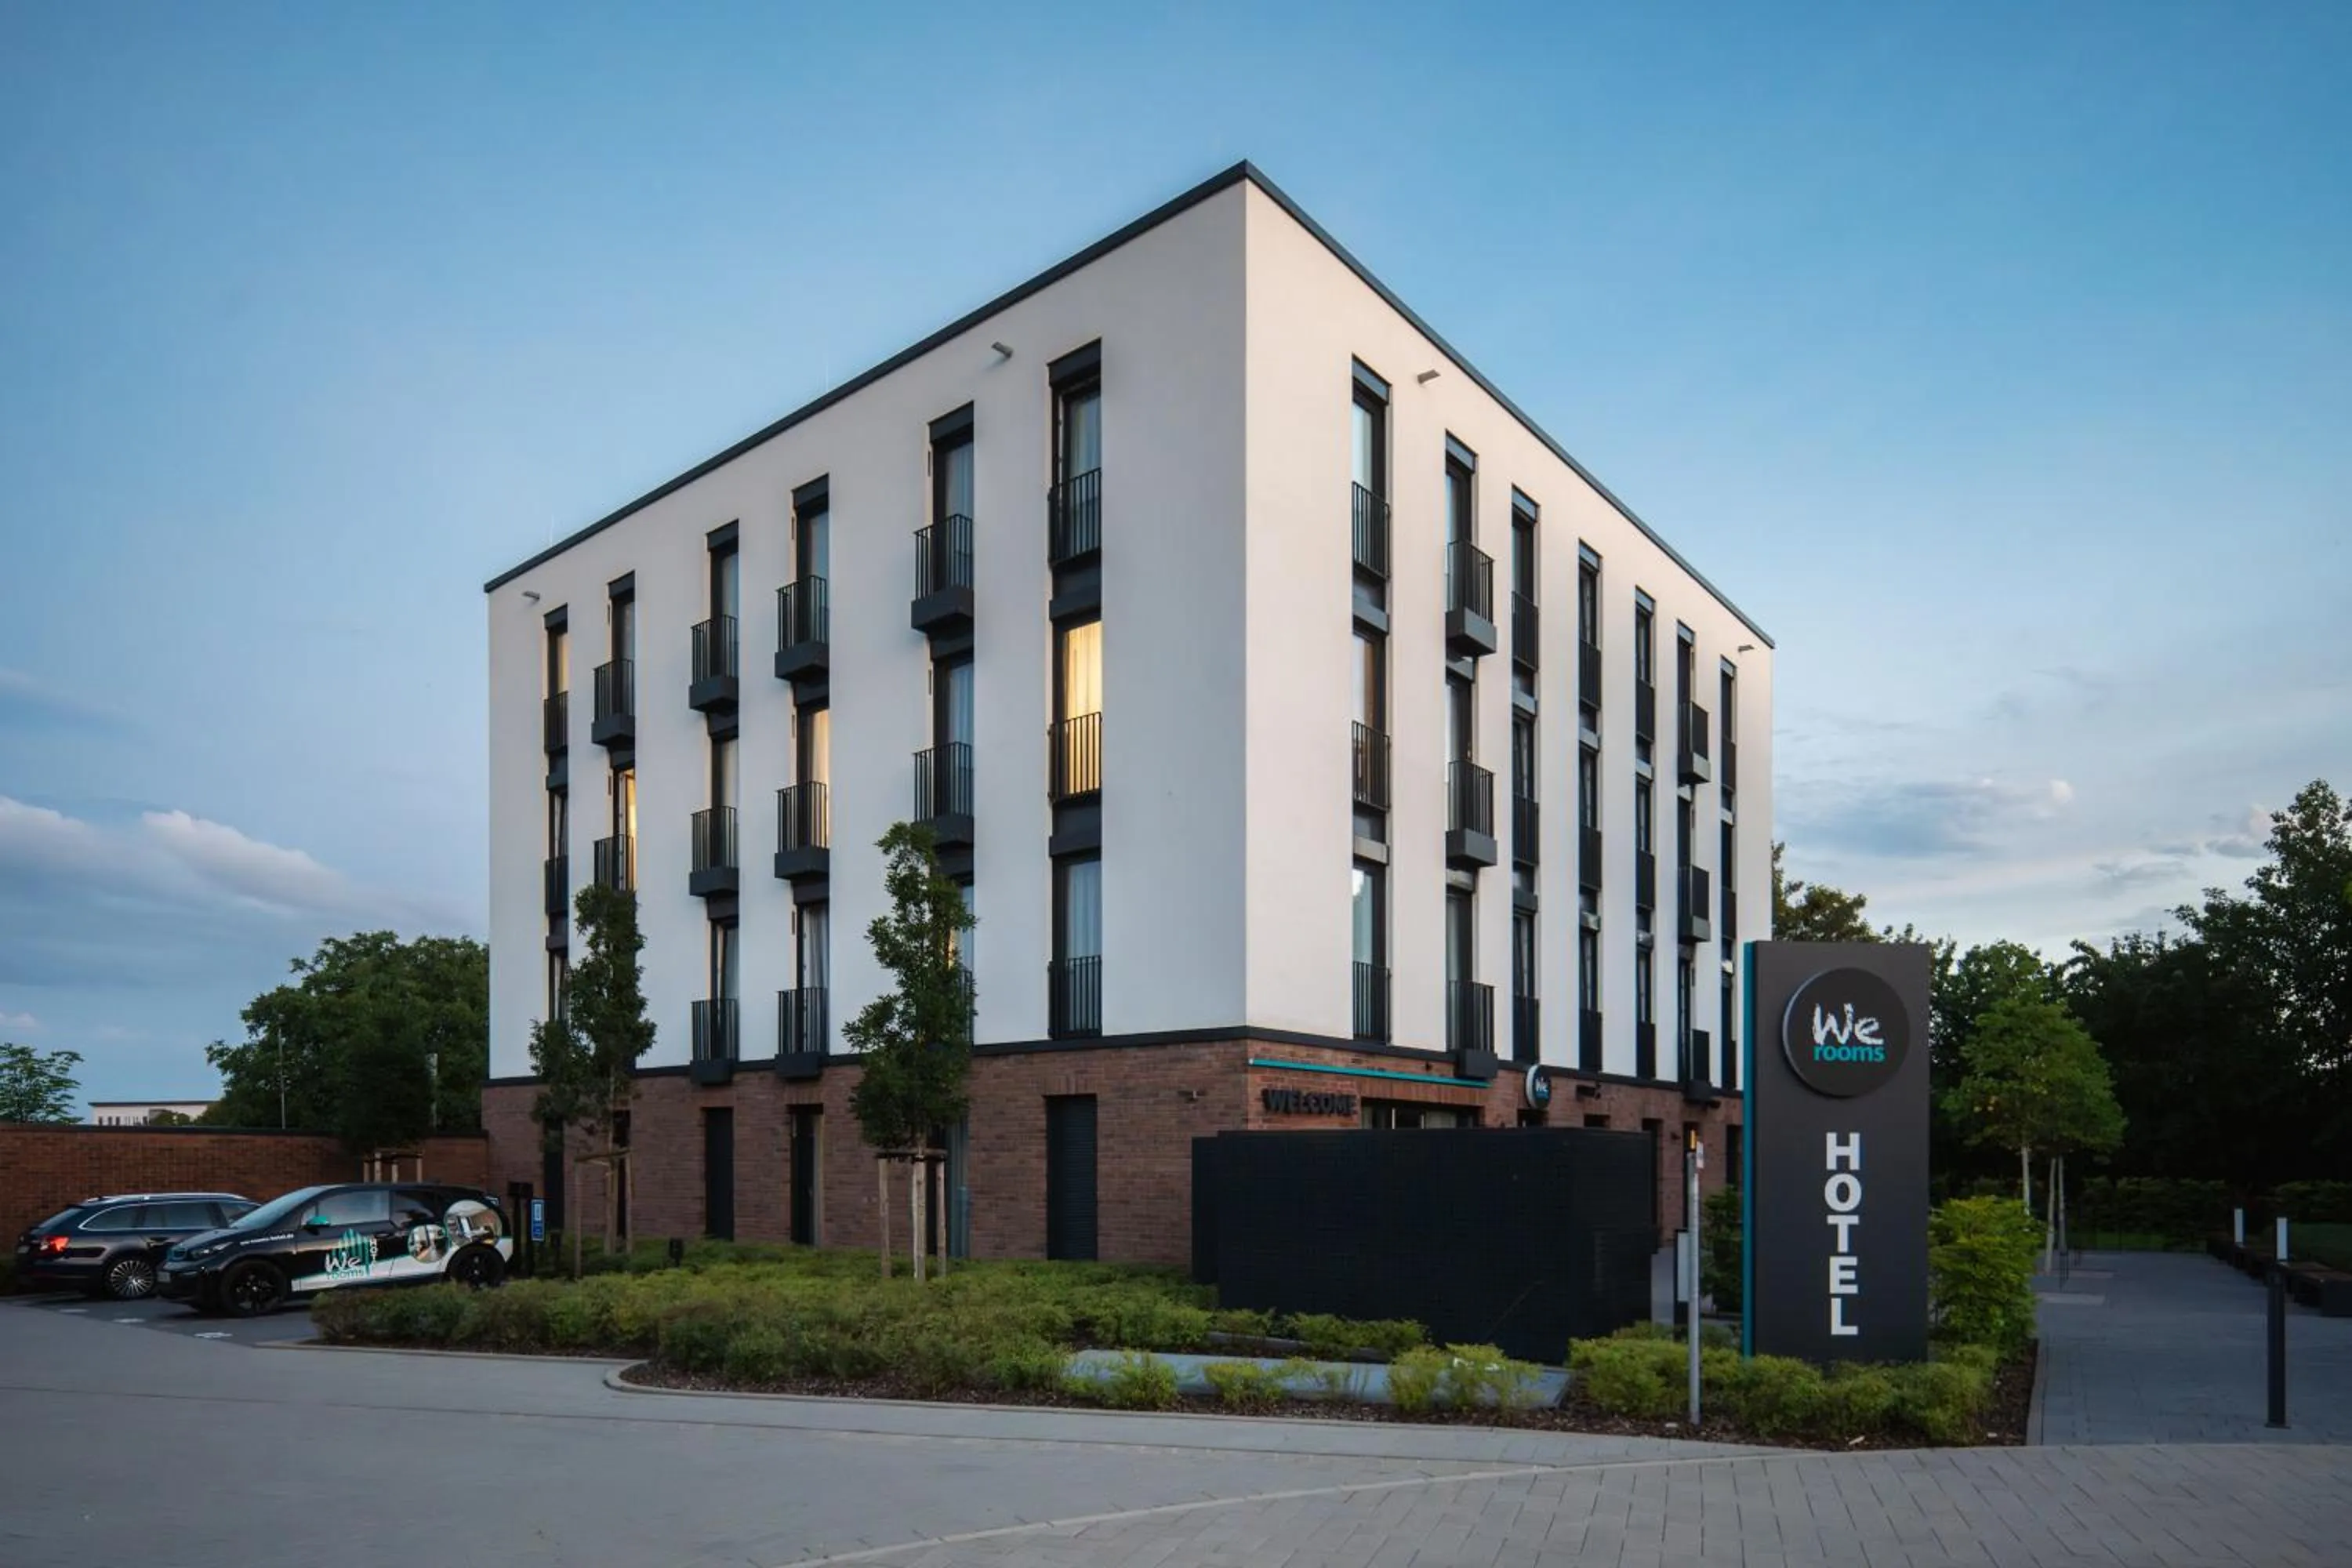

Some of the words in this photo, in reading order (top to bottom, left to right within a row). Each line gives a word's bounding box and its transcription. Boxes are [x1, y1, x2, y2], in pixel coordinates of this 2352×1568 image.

[1812, 1003, 1885, 1046] We
[1813, 1045, 1886, 1062] rooms
[1261, 1087, 1358, 1116] WELCOME
[1824, 1131, 1863, 1336] HOTEL
[325, 1250, 361, 1272] We
